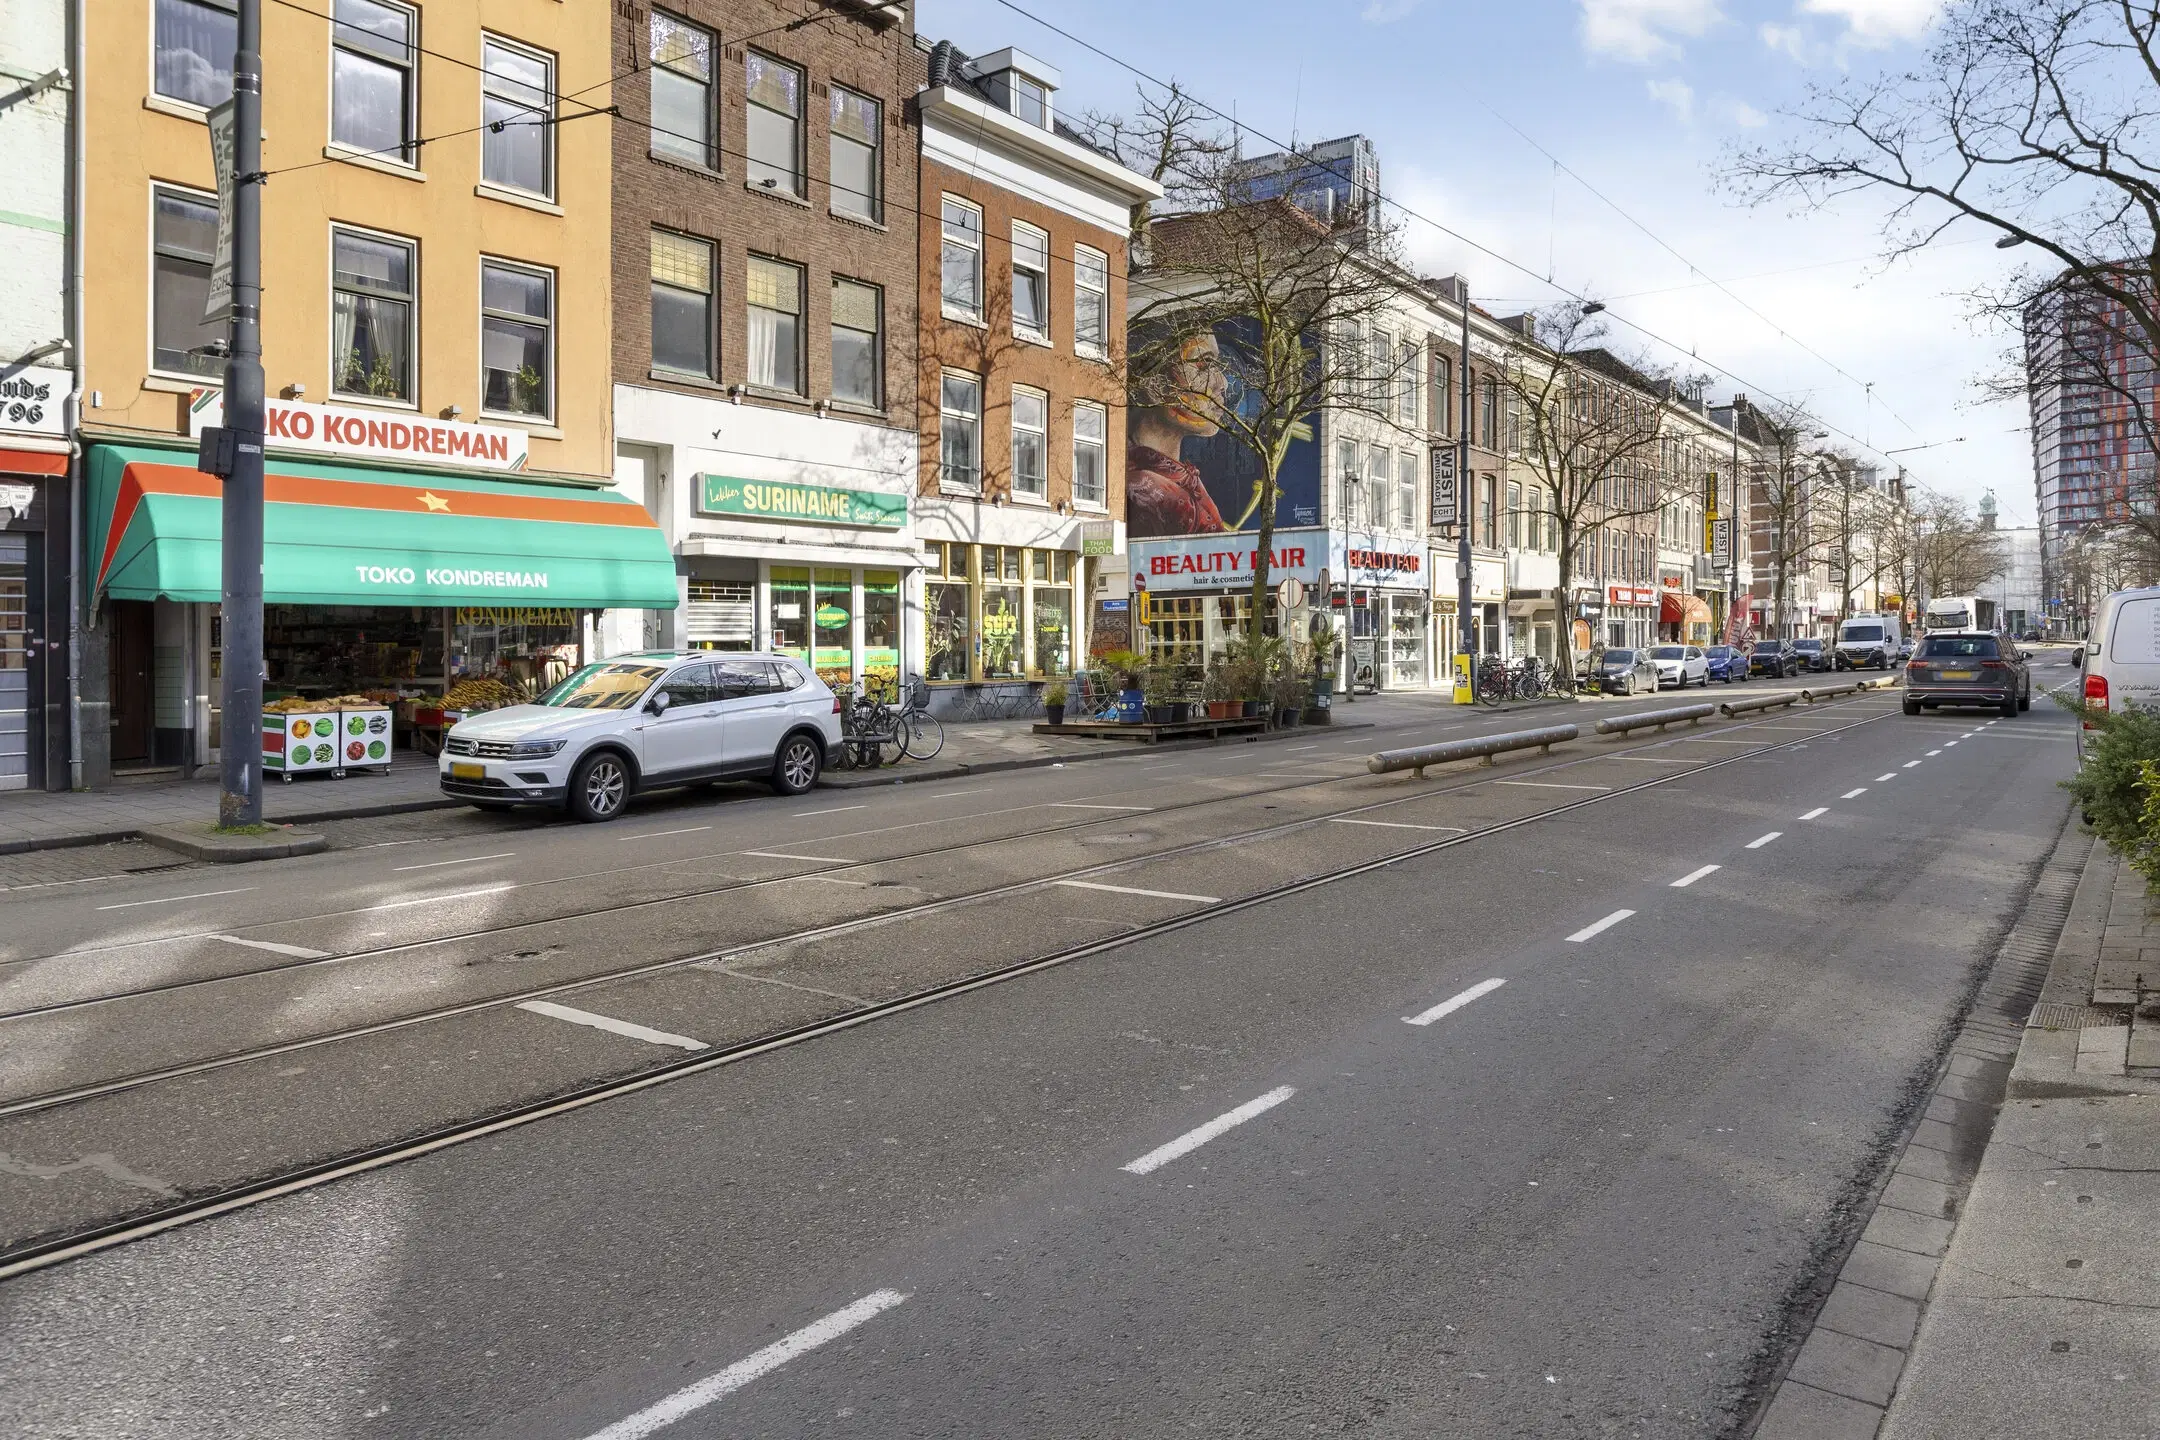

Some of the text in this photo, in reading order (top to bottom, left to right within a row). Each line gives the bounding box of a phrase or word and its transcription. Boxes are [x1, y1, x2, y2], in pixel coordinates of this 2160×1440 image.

[0, 377, 50, 401] nds
[323, 415, 509, 461] KONDREMAN
[743, 484, 850, 518] SURINAME
[1433, 508, 1454, 516] ECHT
[1085, 546, 1113, 555] FOOD
[1089, 540, 1106, 548] THAI
[1150, 551, 1243, 576] BEAUTY
[1348, 549, 1420, 571] BEAUTY FAIR
[356, 566, 549, 589] TOKO KONDREMAN
[1193, 573, 1255, 585] hair & cosmetic
[456, 606, 577, 626] KONDREMAN
